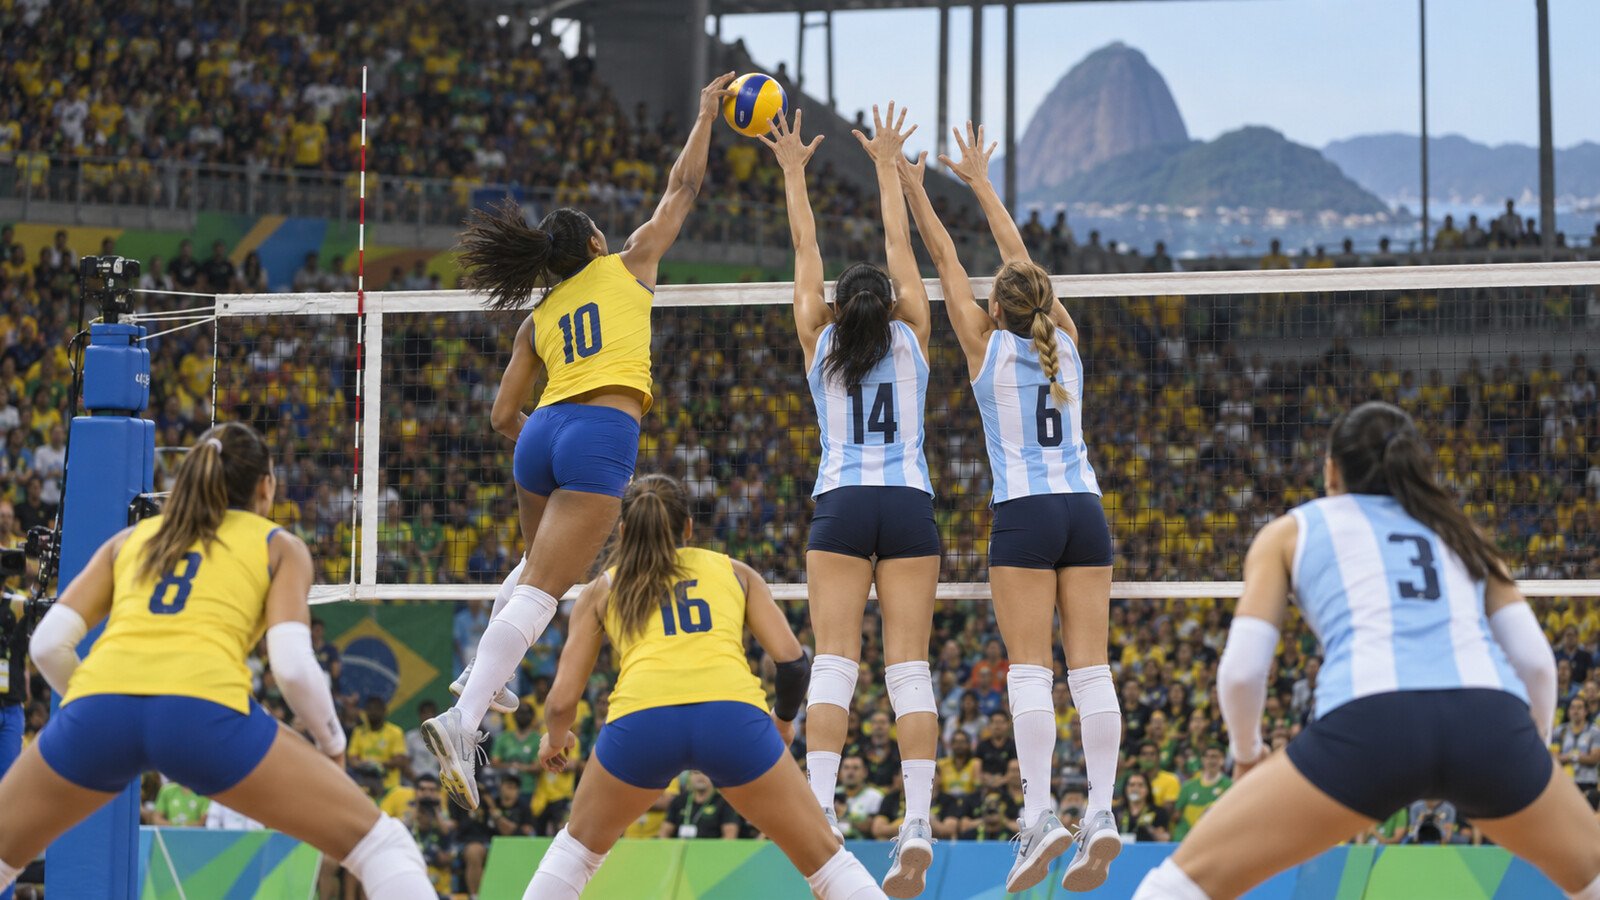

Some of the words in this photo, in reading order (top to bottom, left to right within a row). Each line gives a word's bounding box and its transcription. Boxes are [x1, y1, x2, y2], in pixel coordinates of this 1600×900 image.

[558, 302, 602, 364] 10
[846, 382, 897, 444] 14
[1036, 385, 1063, 447] 6
[148, 551, 202, 614] 8
[1388, 533, 1441, 600] 3
[658, 579, 713, 636] 16
